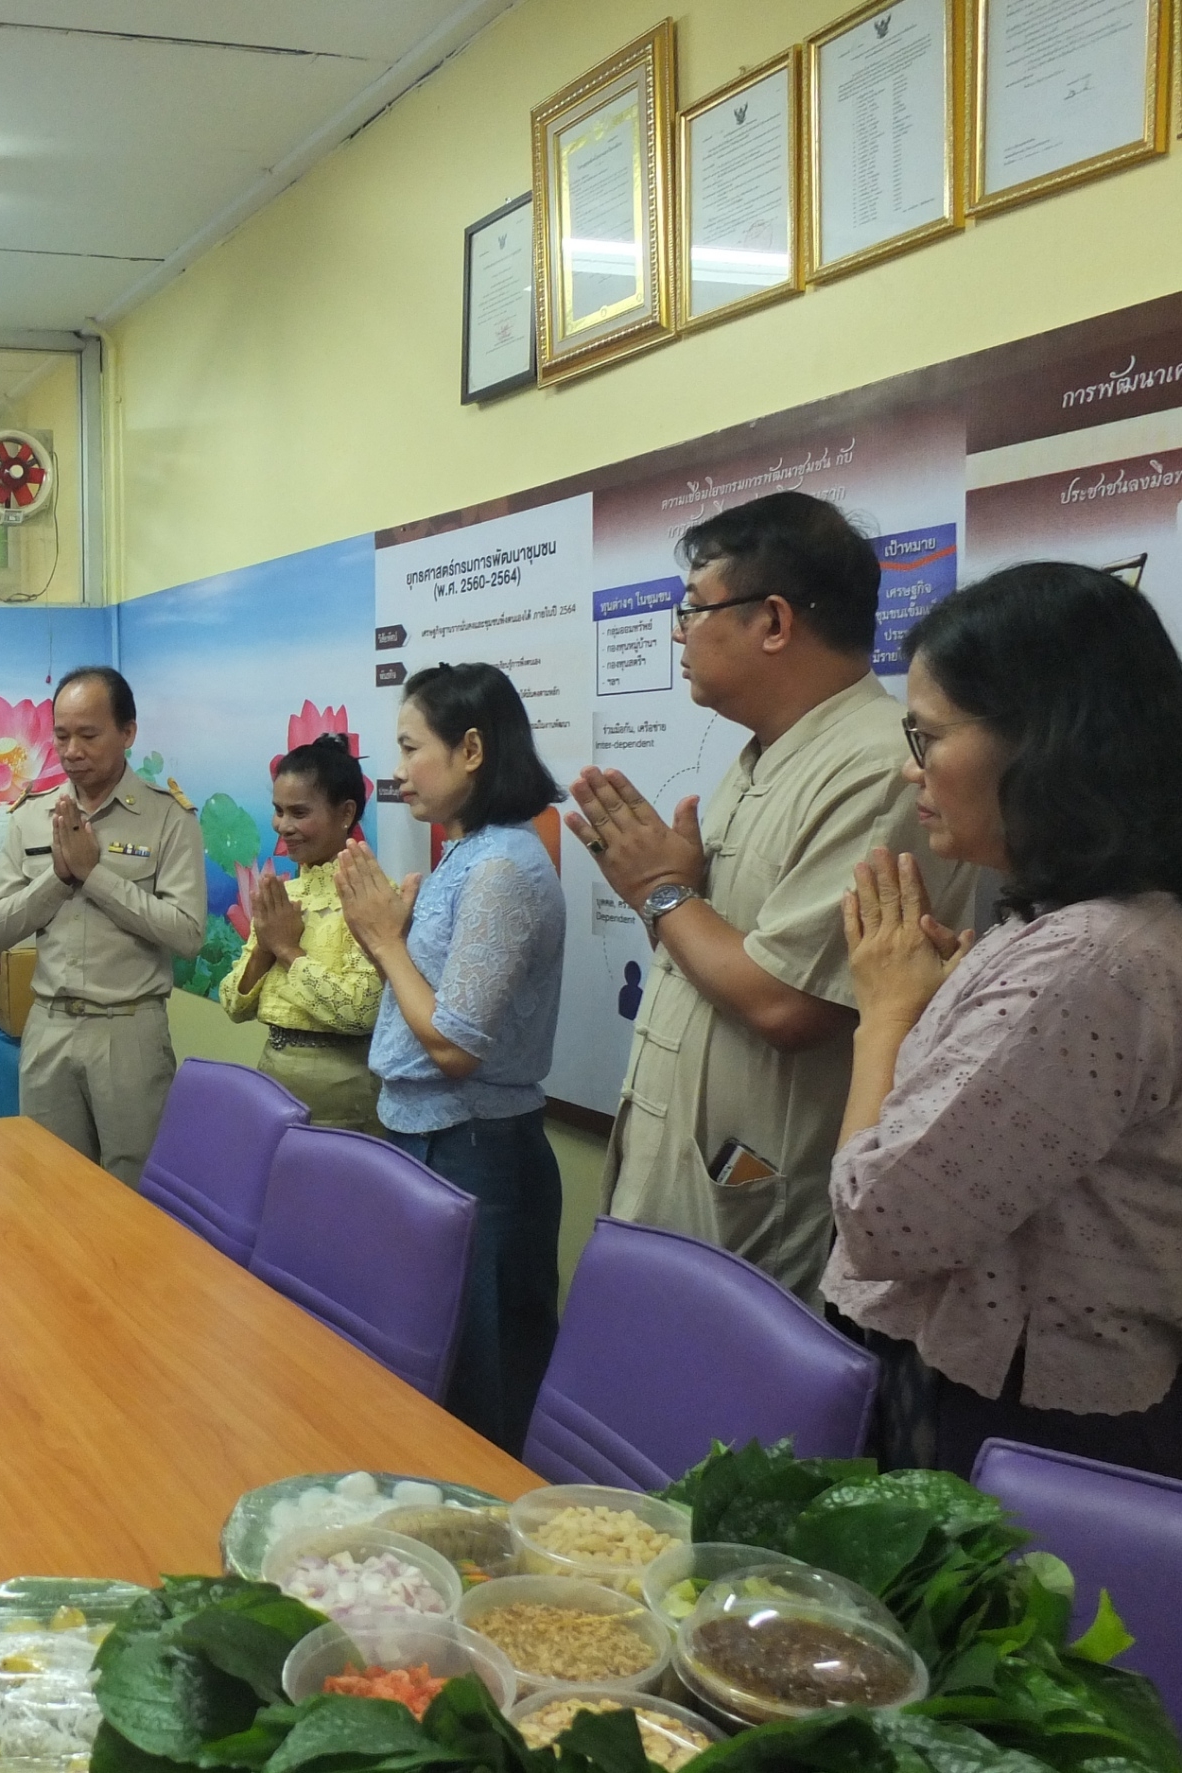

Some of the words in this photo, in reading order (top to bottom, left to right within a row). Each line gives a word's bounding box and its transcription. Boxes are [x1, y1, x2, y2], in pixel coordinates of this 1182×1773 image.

[661, 447, 831, 510] ความเชื่อมโยงกรมการพัฒนาชุมชน
[835, 437, 855, 466] กับ
[884, 537, 937, 557] เป้าหมาย
[406, 540, 557, 591] ยุทธศาสตร์กรมการพัฒนาชุมชน
[433, 581, 458, 602] (พ.ศ.
[460, 566, 522, 594] 2560-2564)
[885, 580, 933, 600] เศรษฐกิจ
[559, 603, 577, 615] 2564
[635, 591, 672, 609] ในชุมชน
[595, 739, 655, 750] Inter-dependent
[596, 911, 636, 923] Dependent
